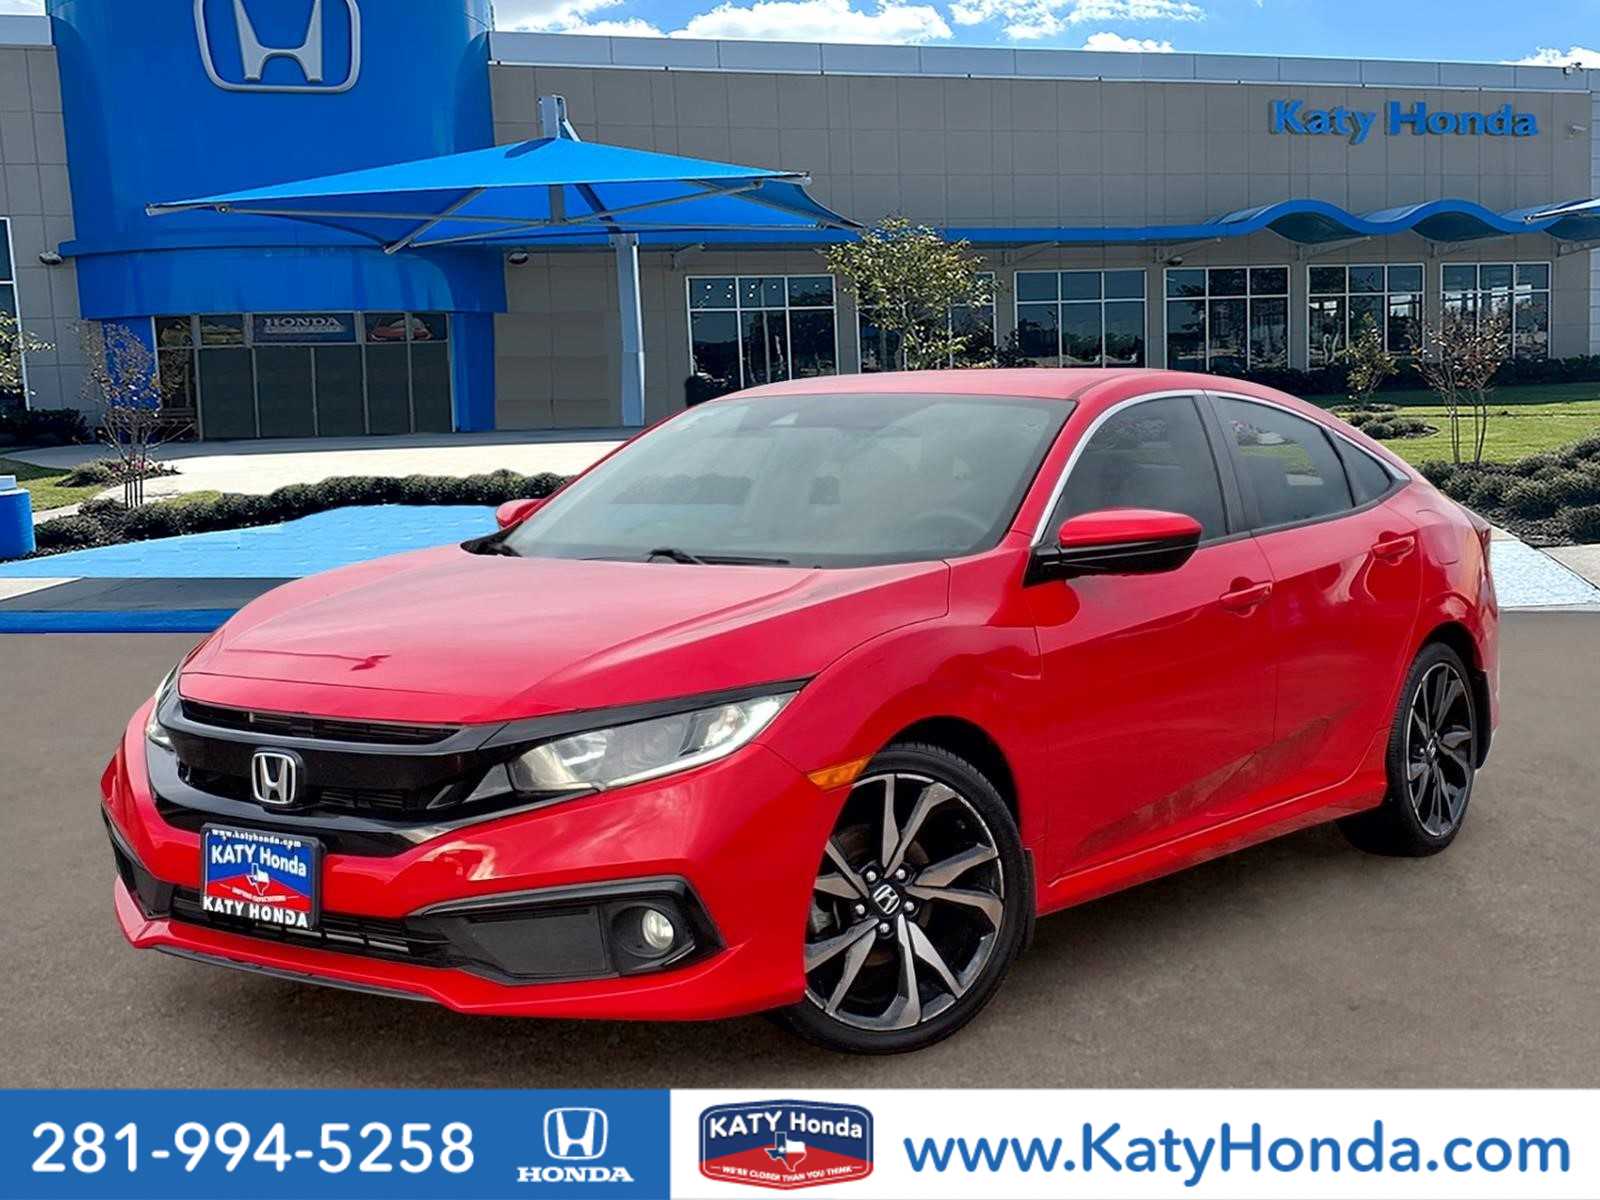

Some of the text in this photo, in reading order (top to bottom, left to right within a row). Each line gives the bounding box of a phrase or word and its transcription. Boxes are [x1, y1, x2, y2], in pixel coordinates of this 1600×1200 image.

[1270, 100, 1539, 145] Katy Honda
[263, 316, 345, 333] HONDA
[211, 844, 307, 877] KATY Honda
[203, 896, 309, 928] KATY HONDA
